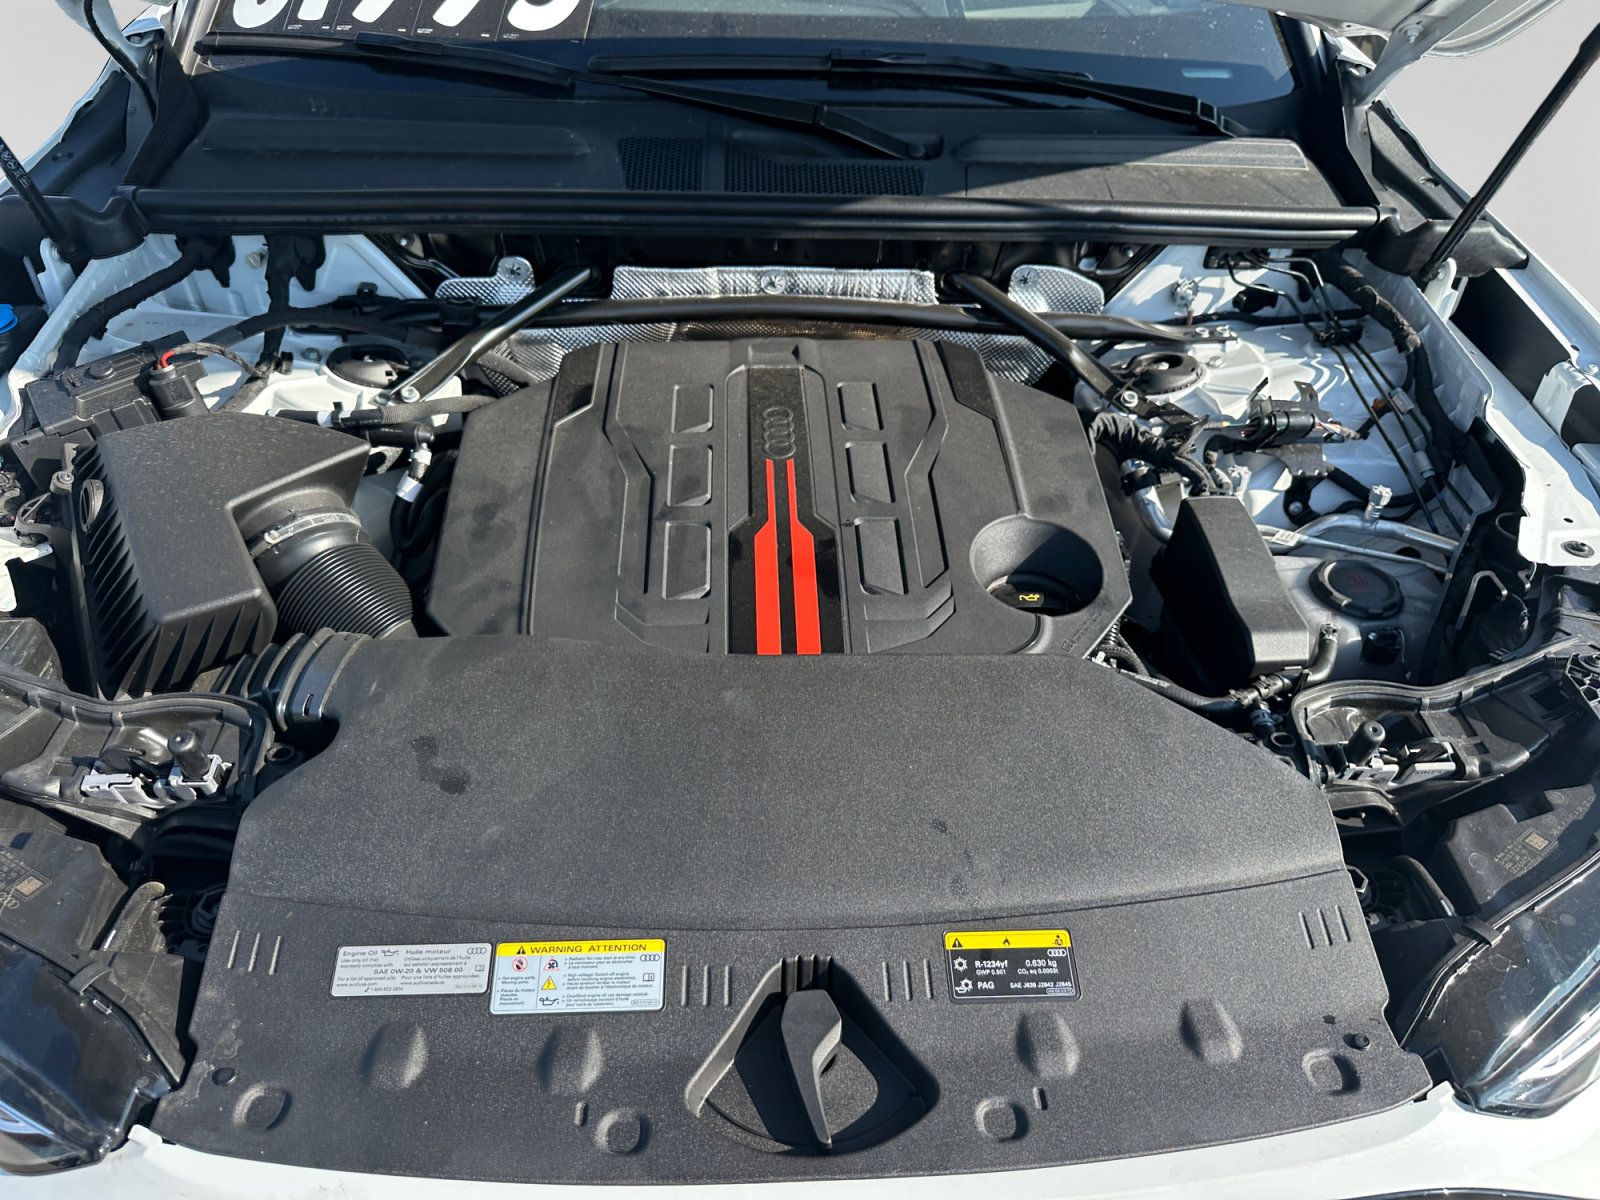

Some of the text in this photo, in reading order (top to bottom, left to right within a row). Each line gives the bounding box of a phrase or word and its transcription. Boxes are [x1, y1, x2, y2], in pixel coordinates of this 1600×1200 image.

[588, 944, 647, 952] ATTENTION
[975, 960, 1008, 969] R-1234yf
[1048, 959, 1057, 968] kg
